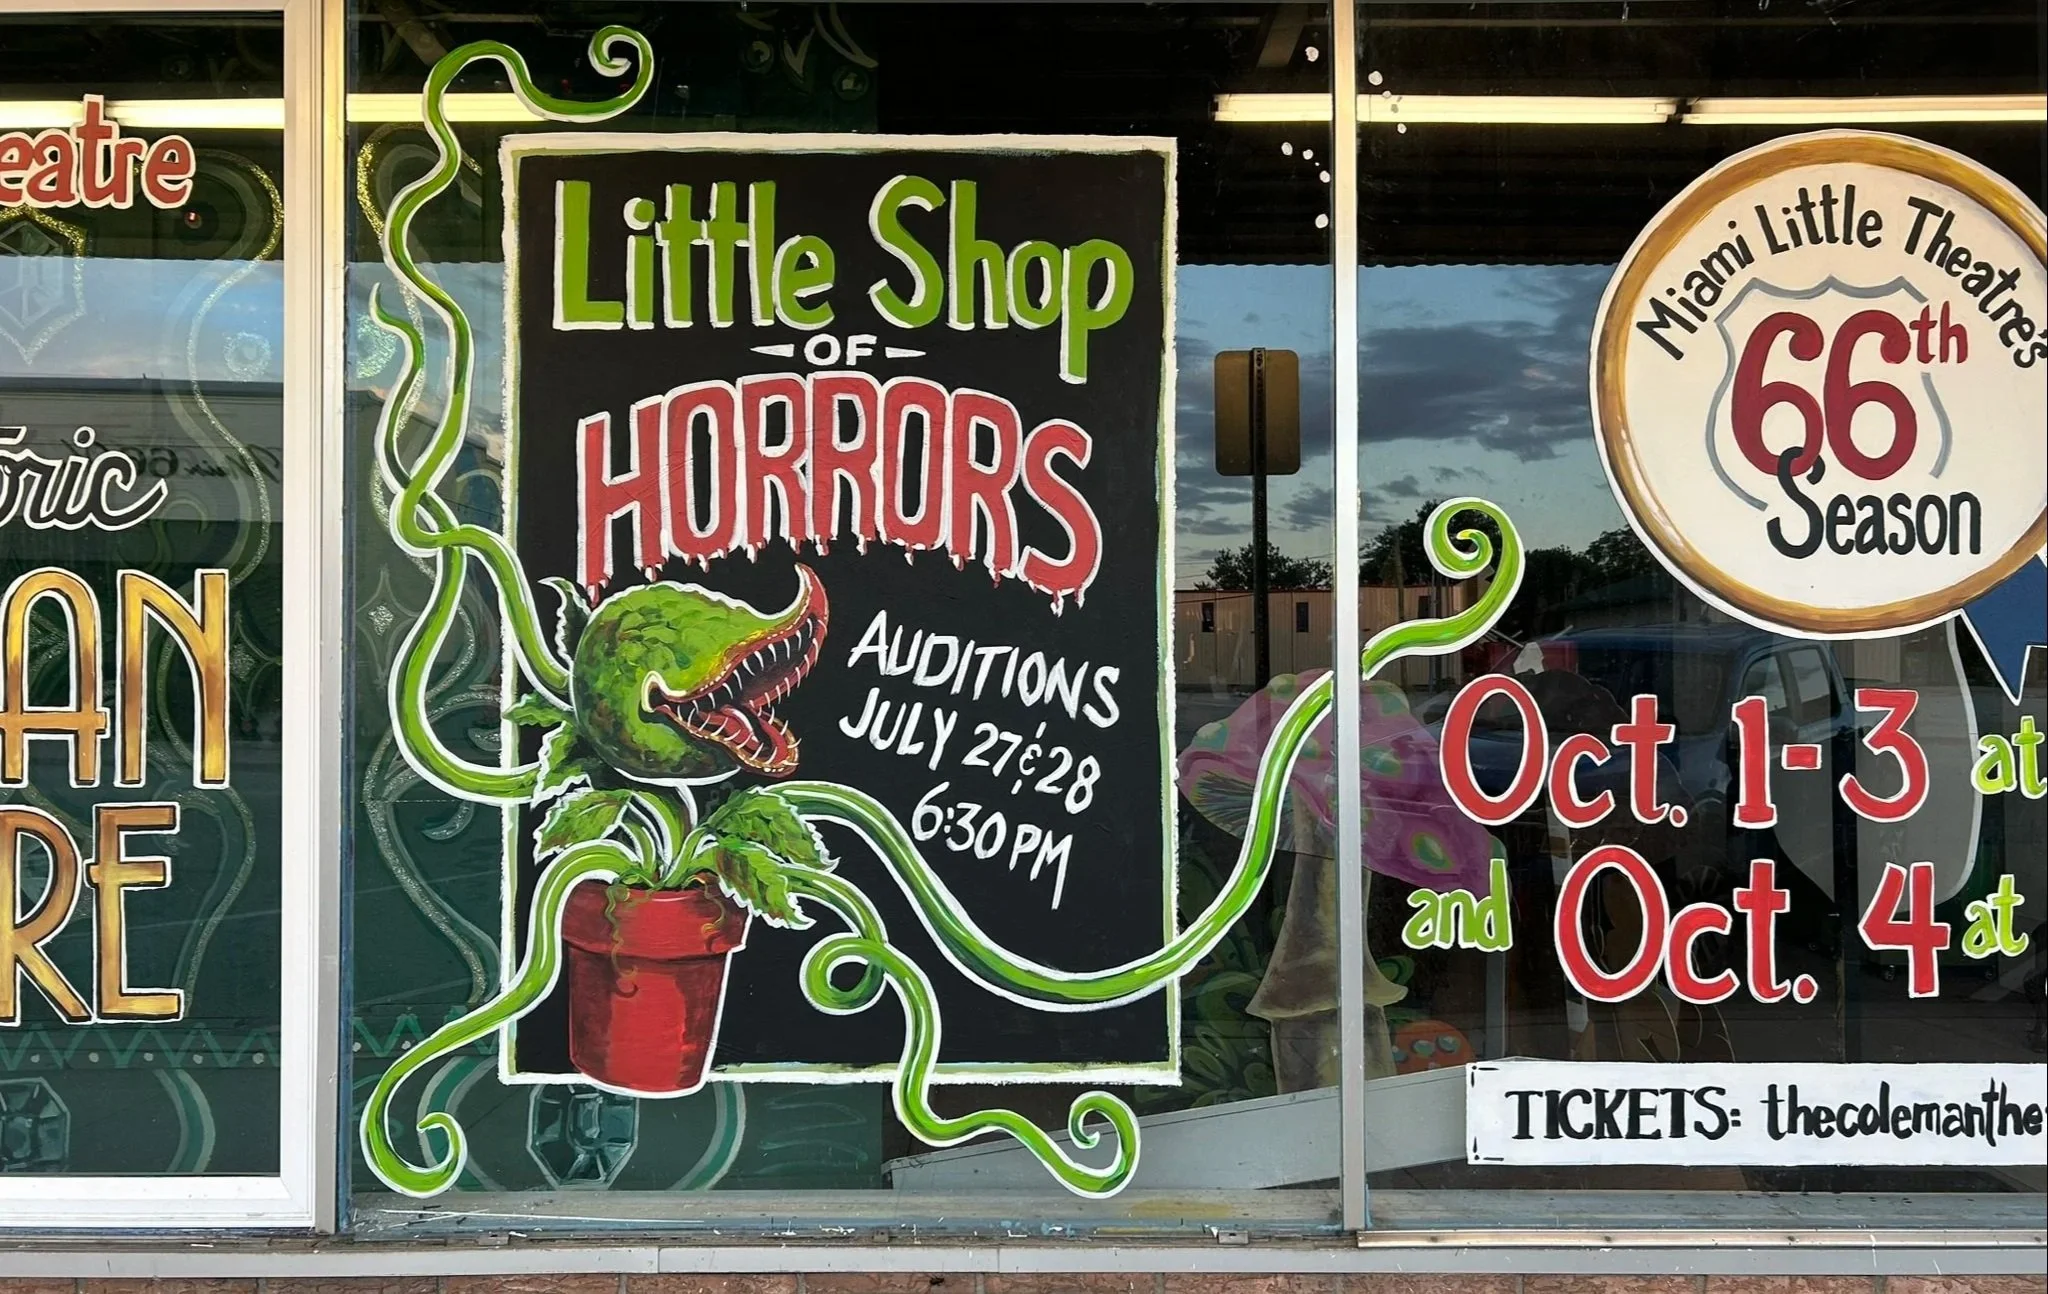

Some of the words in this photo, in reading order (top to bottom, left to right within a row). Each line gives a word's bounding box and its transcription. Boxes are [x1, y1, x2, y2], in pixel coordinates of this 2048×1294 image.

[553, 179, 835, 330] Little
[868, 174, 1134, 384] Shop
[1636, 220, 1756, 361] Miami
[1754, 183, 1883, 256] Little
[1904, 196, 2047, 368] Theatre's
[805, 334, 877, 365] OF
[0, 426, 168, 531] oric
[577, 371, 1101, 616] HORRORS
[1766, 446, 1982, 559] Season
[0, 567, 230, 788] AN
[839, 687, 958, 771] JULY
[848, 609, 1120, 728] AUDITIONS
[1438, 673, 1688, 828] Oct.
[1971, 716, 2047, 799] at
[912, 781, 1007, 860] 6:30
[1009, 823, 1073, 910] PM
[1402, 859, 1513, 952] and
[1553, 844, 1818, 1005] Oct.
[1857, 861, 1951, 999] 4
[1962, 874, 2029, 959] at
[1504, 1085, 1741, 1141] TICKETS:
[1760, 1077, 2047, 1147] thecolemanthe
